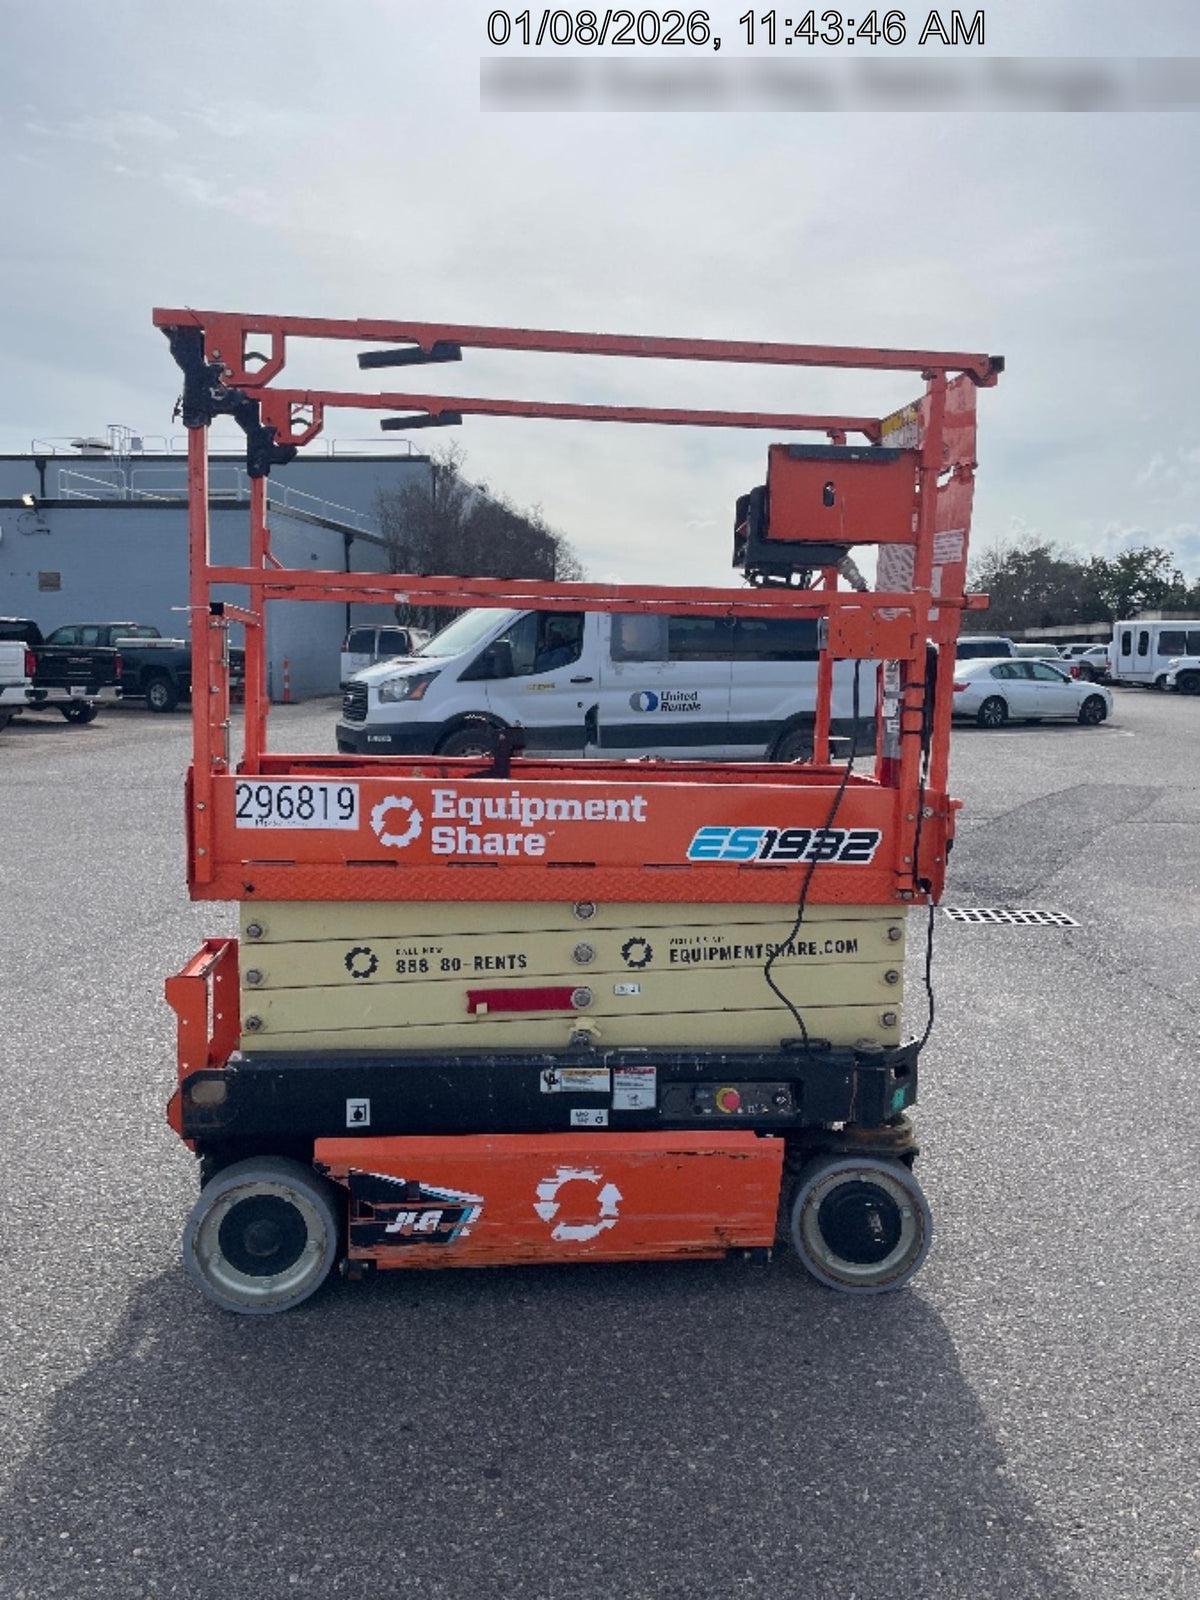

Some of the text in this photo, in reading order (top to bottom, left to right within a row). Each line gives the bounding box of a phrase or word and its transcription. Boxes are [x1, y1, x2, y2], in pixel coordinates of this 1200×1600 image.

[660, 701, 702, 712] Rentals
[661, 690, 698, 701] United
[235, 783, 355, 820] 296819
[431, 789, 648, 827] Equipment
[431, 826, 546, 856] Share
[687, 826, 882, 864] ES1932
[396, 954, 528, 973] 888 80-RENTS
[669, 938, 858, 964] EQUIPMENTSHARE.COM
